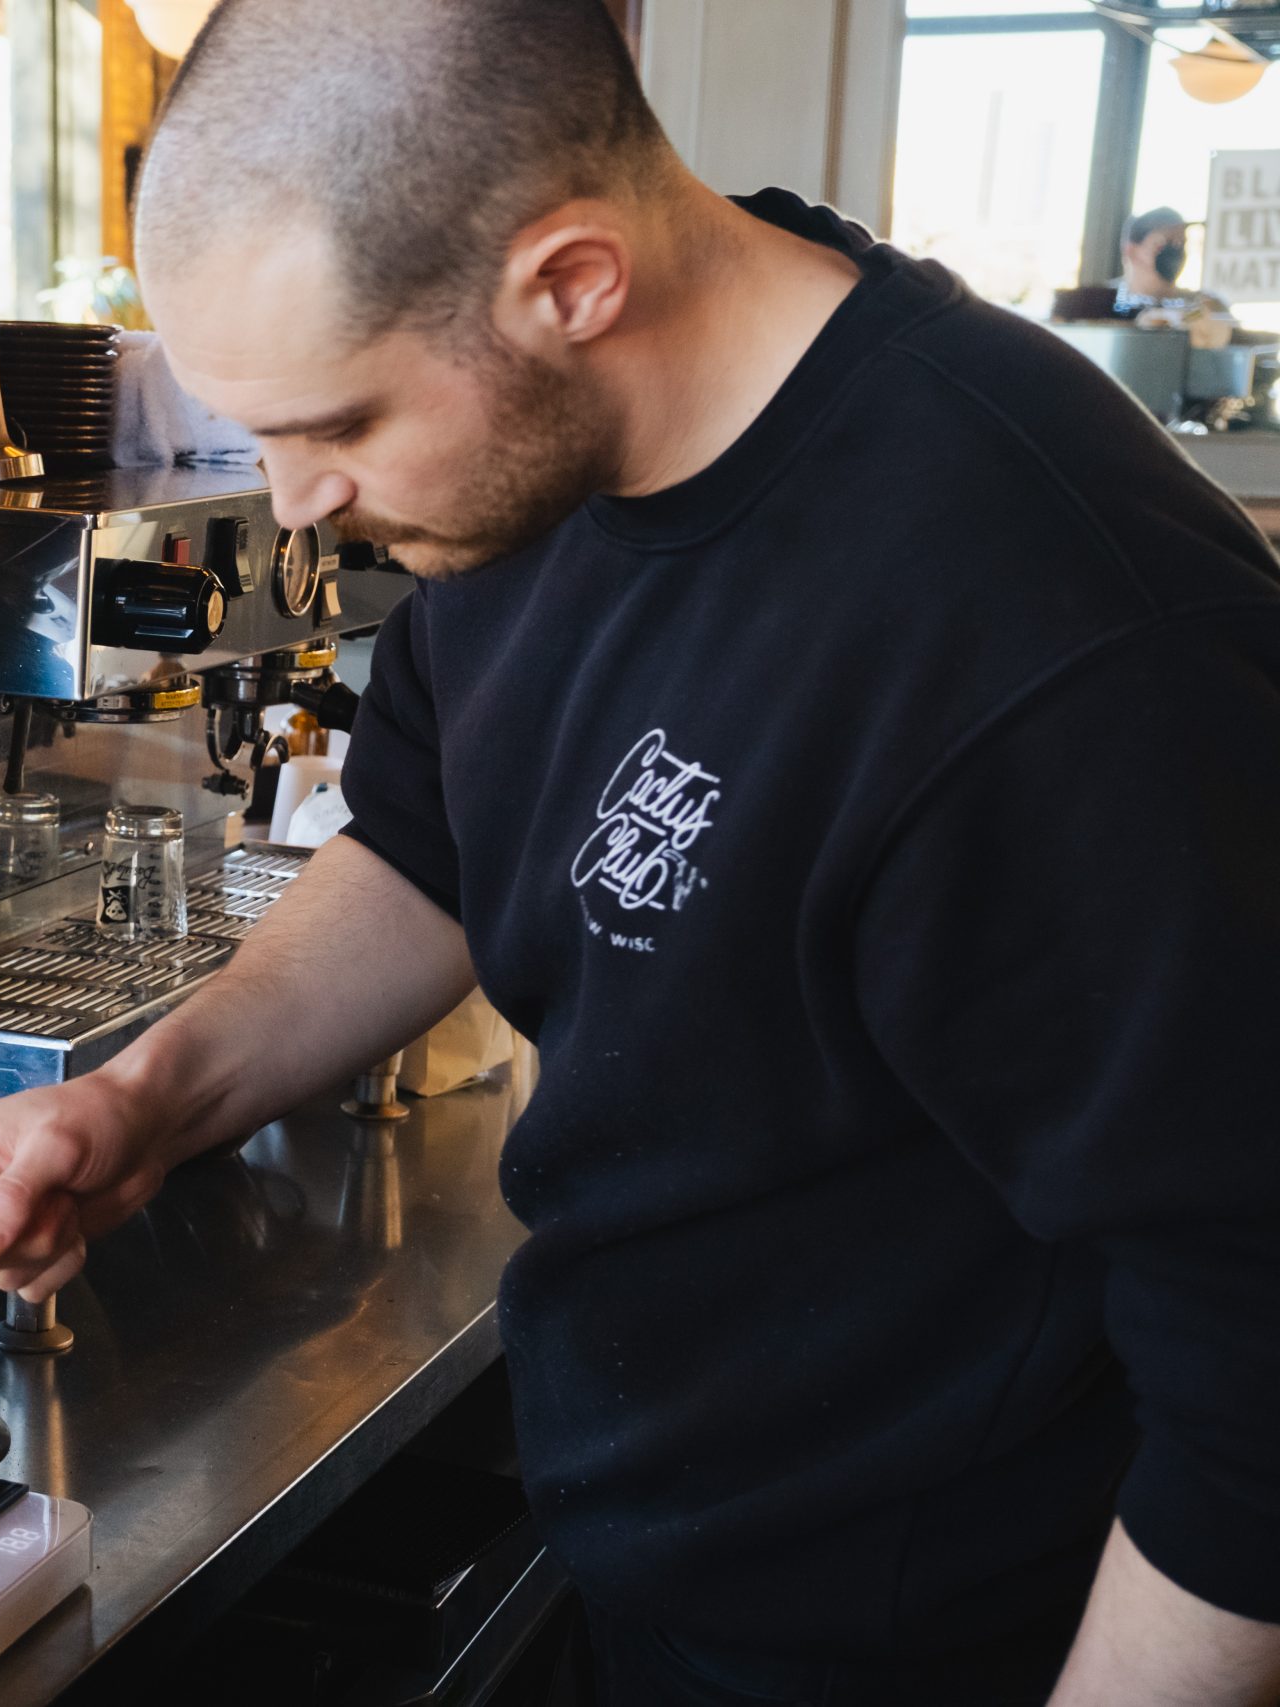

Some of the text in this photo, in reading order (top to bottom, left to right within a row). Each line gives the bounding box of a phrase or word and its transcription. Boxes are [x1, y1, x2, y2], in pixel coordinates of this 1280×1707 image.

[1222, 165, 1280, 200] BL
[597, 728, 720, 850] Cactus
[571, 813, 669, 909] Club
